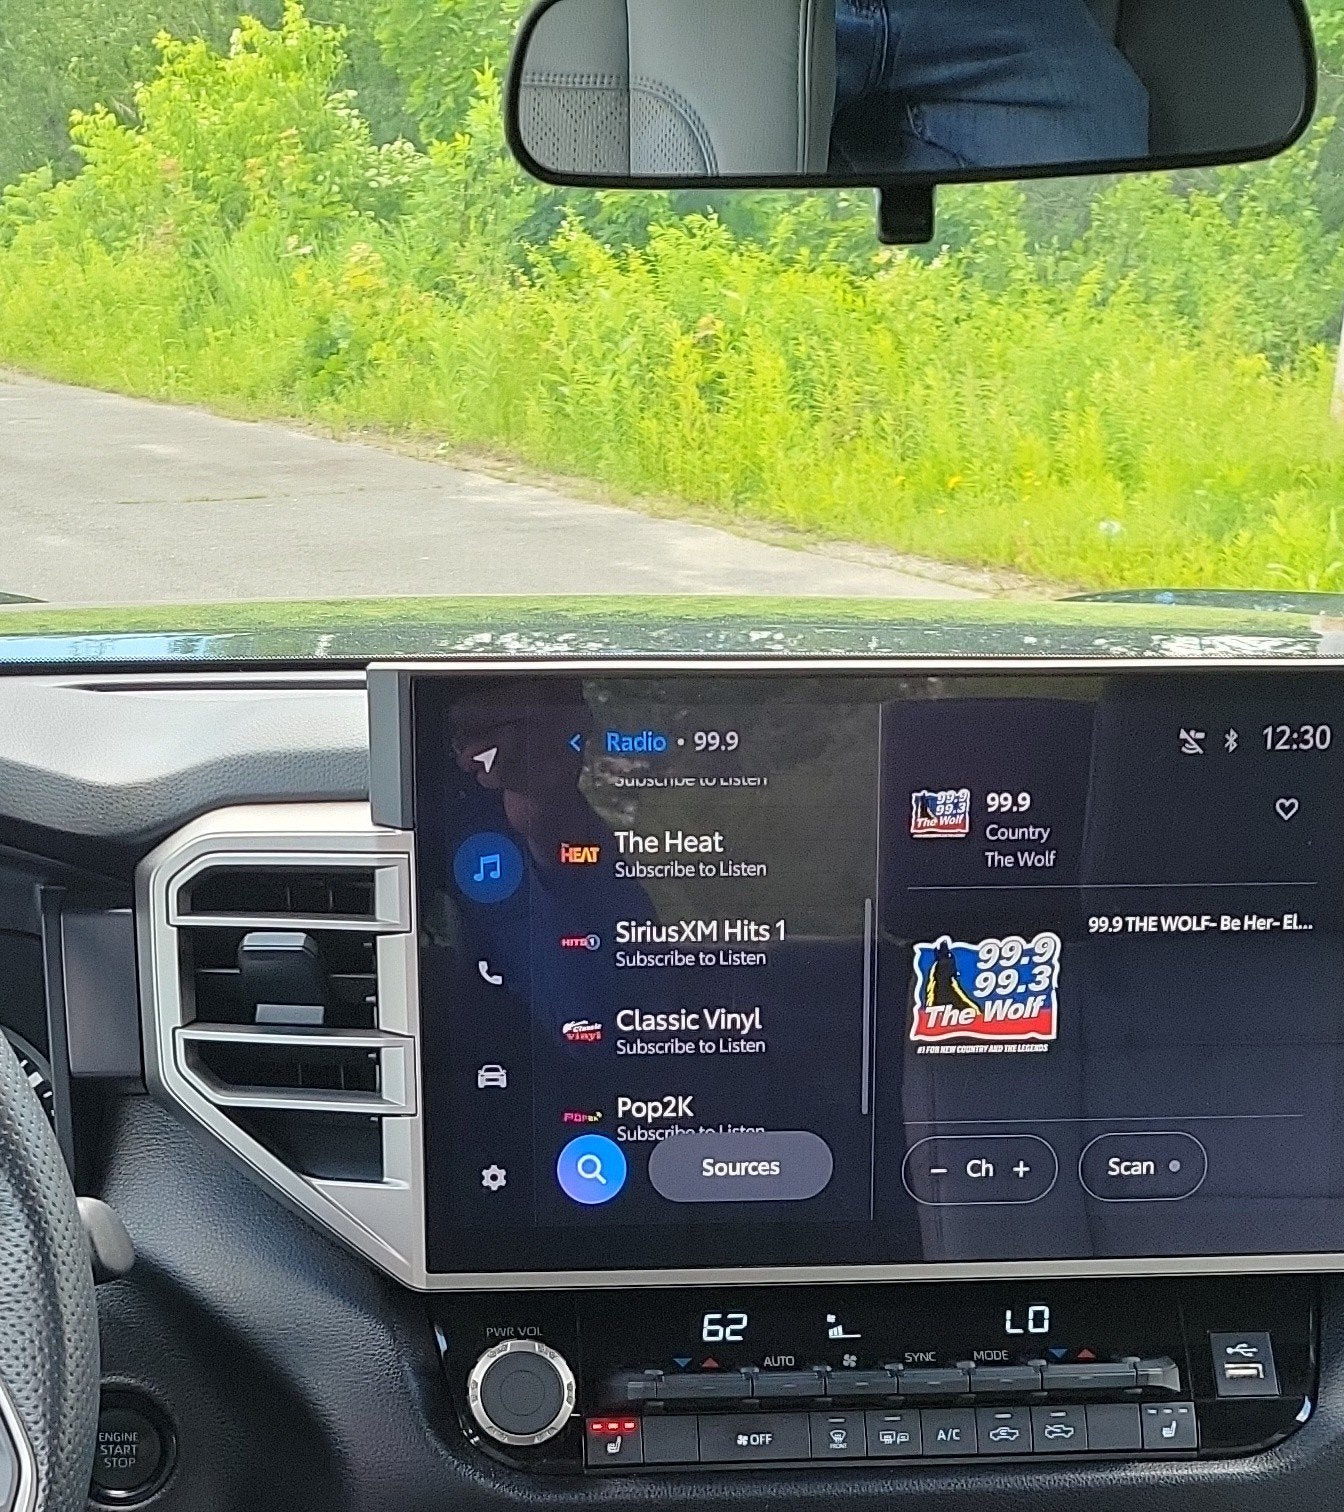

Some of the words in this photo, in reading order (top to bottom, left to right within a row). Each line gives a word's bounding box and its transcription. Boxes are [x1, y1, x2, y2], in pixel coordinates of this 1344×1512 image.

[606, 731, 667, 752] Radio
[693, 731, 739, 751] 99.9
[1263, 725, 1331, 751] 12:30
[986, 792, 1031, 813] 99.9
[614, 830, 659, 853] The
[665, 830, 724, 853] Heat
[986, 824, 1050, 843] Country
[985, 851, 1014, 867] The
[1017, 850, 1056, 867] Wolf
[615, 861, 695, 878] Subscribe
[699, 861, 716, 877] to
[720, 860, 766, 877] Listen
[615, 919, 717, 944] SiriusXM
[724, 918, 770, 942] Hits
[775, 920, 786, 941] 1
[1088, 916, 1123, 933] 99.9
[1125, 916, 1158, 932] THE
[1220, 915, 1241, 931] Be
[615, 951, 696, 968] Subscribe
[699, 951, 716, 967] to
[720, 950, 766, 967] Listen
[977, 937, 1055, 969] 99.9
[973, 965, 1052, 998] 99.3
[616, 1009, 699, 1032] Classic
[703, 1007, 762, 1032] Vinyl
[925, 1004, 977, 1029] The
[983, 994, 1047, 1023] Wolf
[616, 1038, 696, 1056] Subscribe
[699, 1039, 716, 1055] to
[719, 1037, 766, 1054] Listen
[617, 1095, 694, 1123] Pop2K
[702, 1158, 780, 1176] Sources
[966, 1159, 994, 1179] Ch
[1108, 1156, 1155, 1176] Scan
[702, 1313, 748, 1341] 62
[1006, 1306, 1050, 1334] LO
[486, 1326, 515, 1338] PWR
[518, 1325, 543, 1337] VOL
[764, 1355, 795, 1367] AUTO
[904, 1351, 937, 1362] SYNC
[974, 1350, 1009, 1361] MODE
[98, 1431, 138, 1443] ENGINE
[749, 1433, 773, 1446] OFF
[937, 1428, 961, 1441] A/C
[100, 1443, 137, 1455] START
[104, 1456, 136, 1468] STOP
